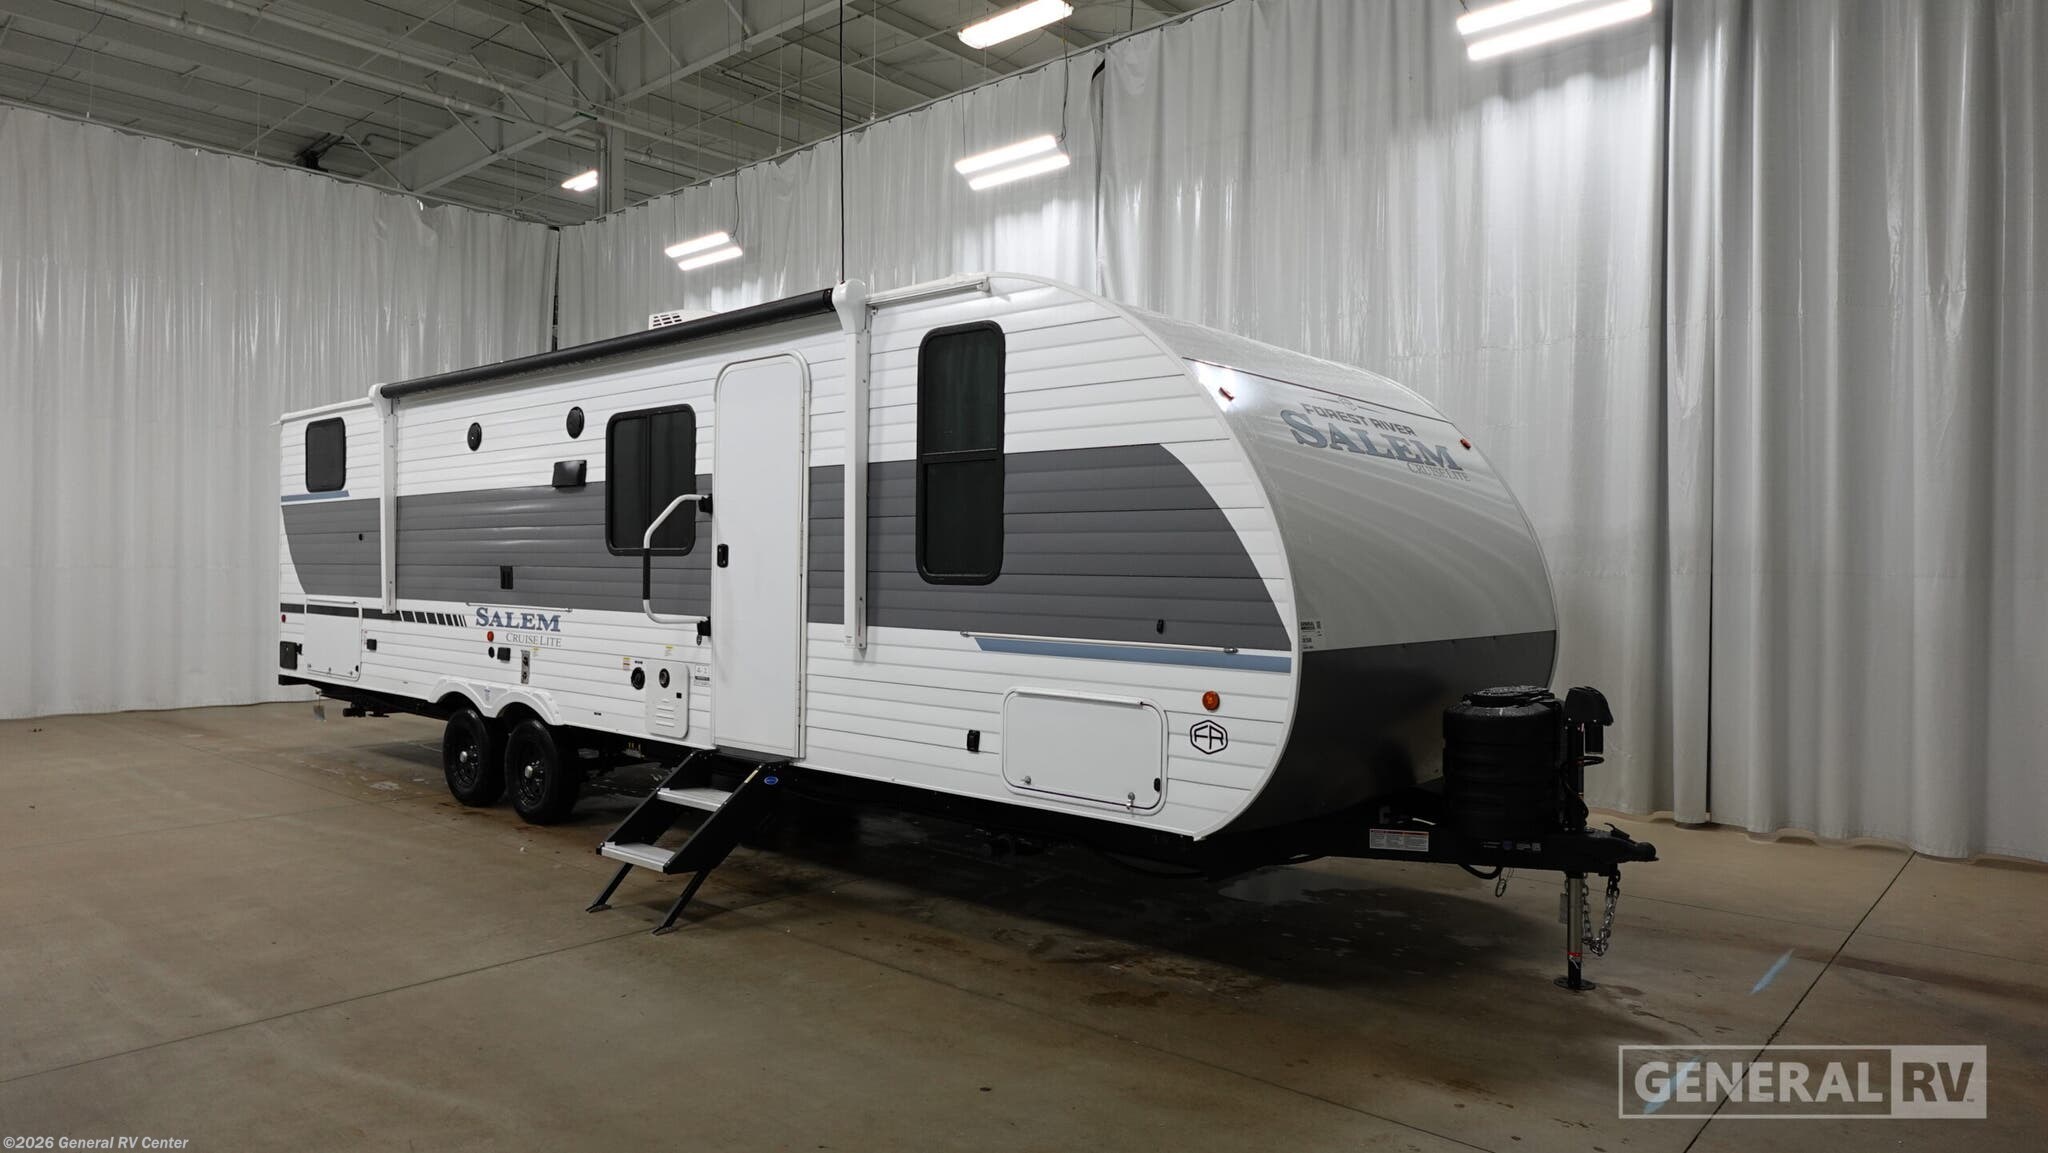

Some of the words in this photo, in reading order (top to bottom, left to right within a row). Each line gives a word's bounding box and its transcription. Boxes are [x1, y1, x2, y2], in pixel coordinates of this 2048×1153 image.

[1302, 404, 1369, 426] FOREST
[1370, 418, 1417, 436] RIVER
[1280, 409, 1463, 471] SALEM
[475, 607, 561, 632] SALEM
